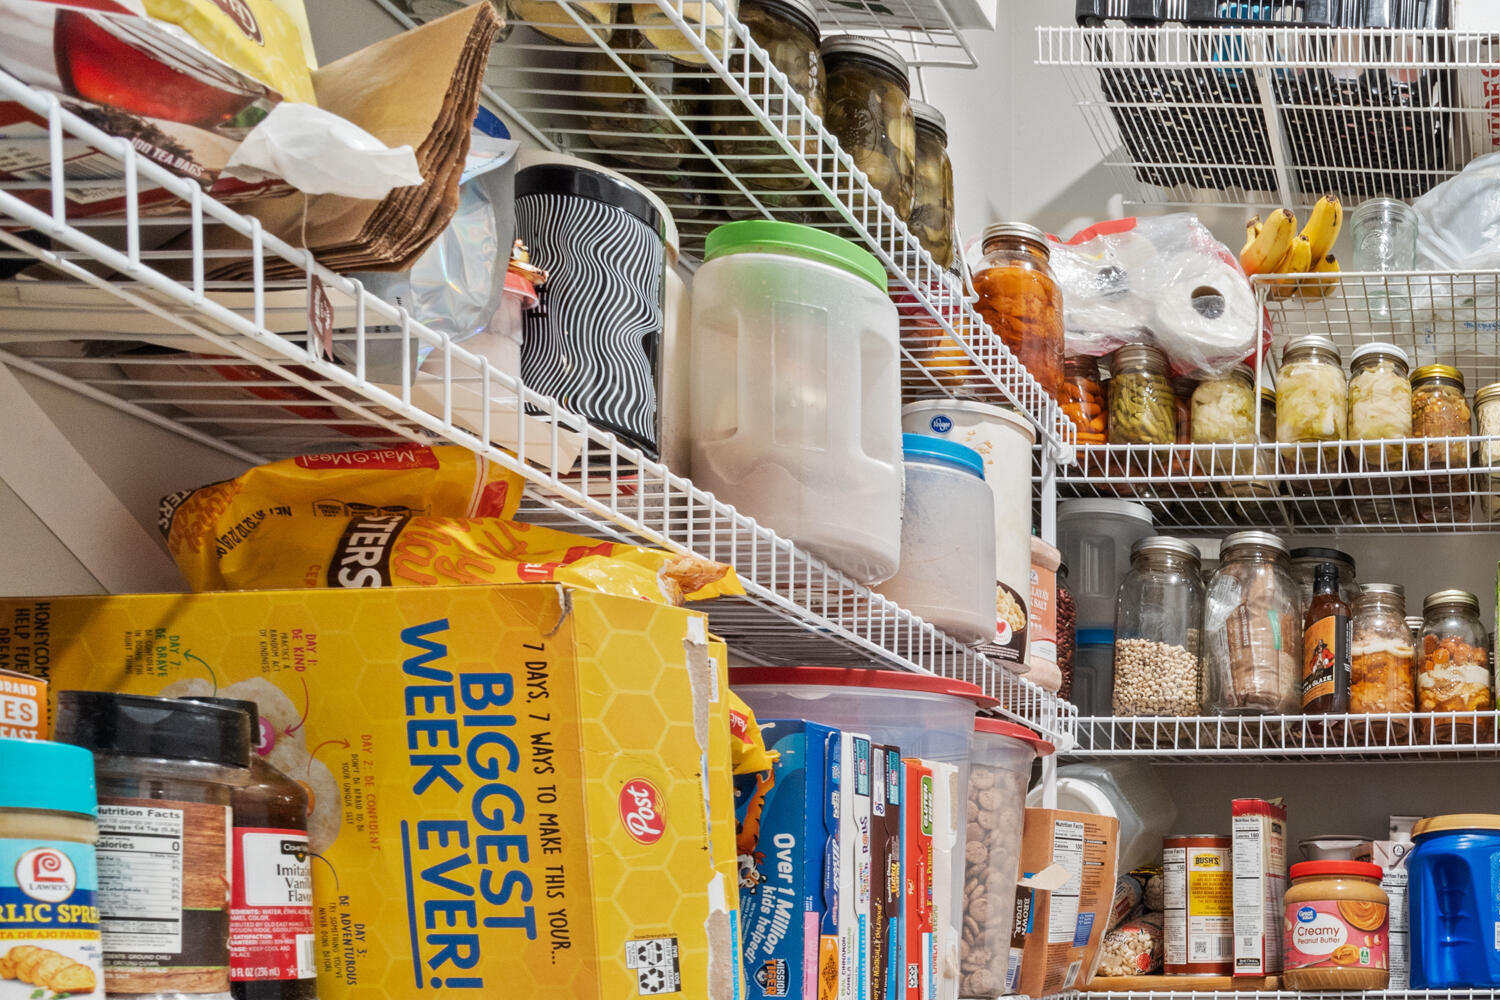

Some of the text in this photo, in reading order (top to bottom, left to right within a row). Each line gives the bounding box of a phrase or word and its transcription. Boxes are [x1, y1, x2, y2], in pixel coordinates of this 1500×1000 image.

[131, 137, 205, 178] 100 TEA BAGS
[15, 608, 31, 640] HELP
[34, 602, 51, 692] HONEYCOM
[291, 628, 306, 673] BE KIND
[305, 633, 317, 658] DAY
[4, 700, 33, 722] ES
[360, 733, 382, 852] DAY BE CONFIDENT
[400, 617, 485, 990] WEEK EVER!
[458, 672, 538, 941] BIGGEST
[521, 642, 572, 966] 7 DAYS, 7 WAYS TO MAKE THIS YOUR...
[626, 784, 662, 837] Post
[146, 808, 181, 820] Facts
[171, 841, 181, 851] 0
[773, 832, 795, 885] Over
[1194, 855, 1220, 866] BUSH'S
[744, 885, 777, 964] kids helped!
[765, 898, 794, 955] Million
[1014, 898, 1023, 937] SUGAR
[1022, 898, 1031, 936] BROWN
[1297, 926, 1340, 938] Creamy
[339, 910, 357, 986] ADVENTUROUS
[763, 958, 777, 997] TIGER
[774, 957, 786, 998] MISSION
